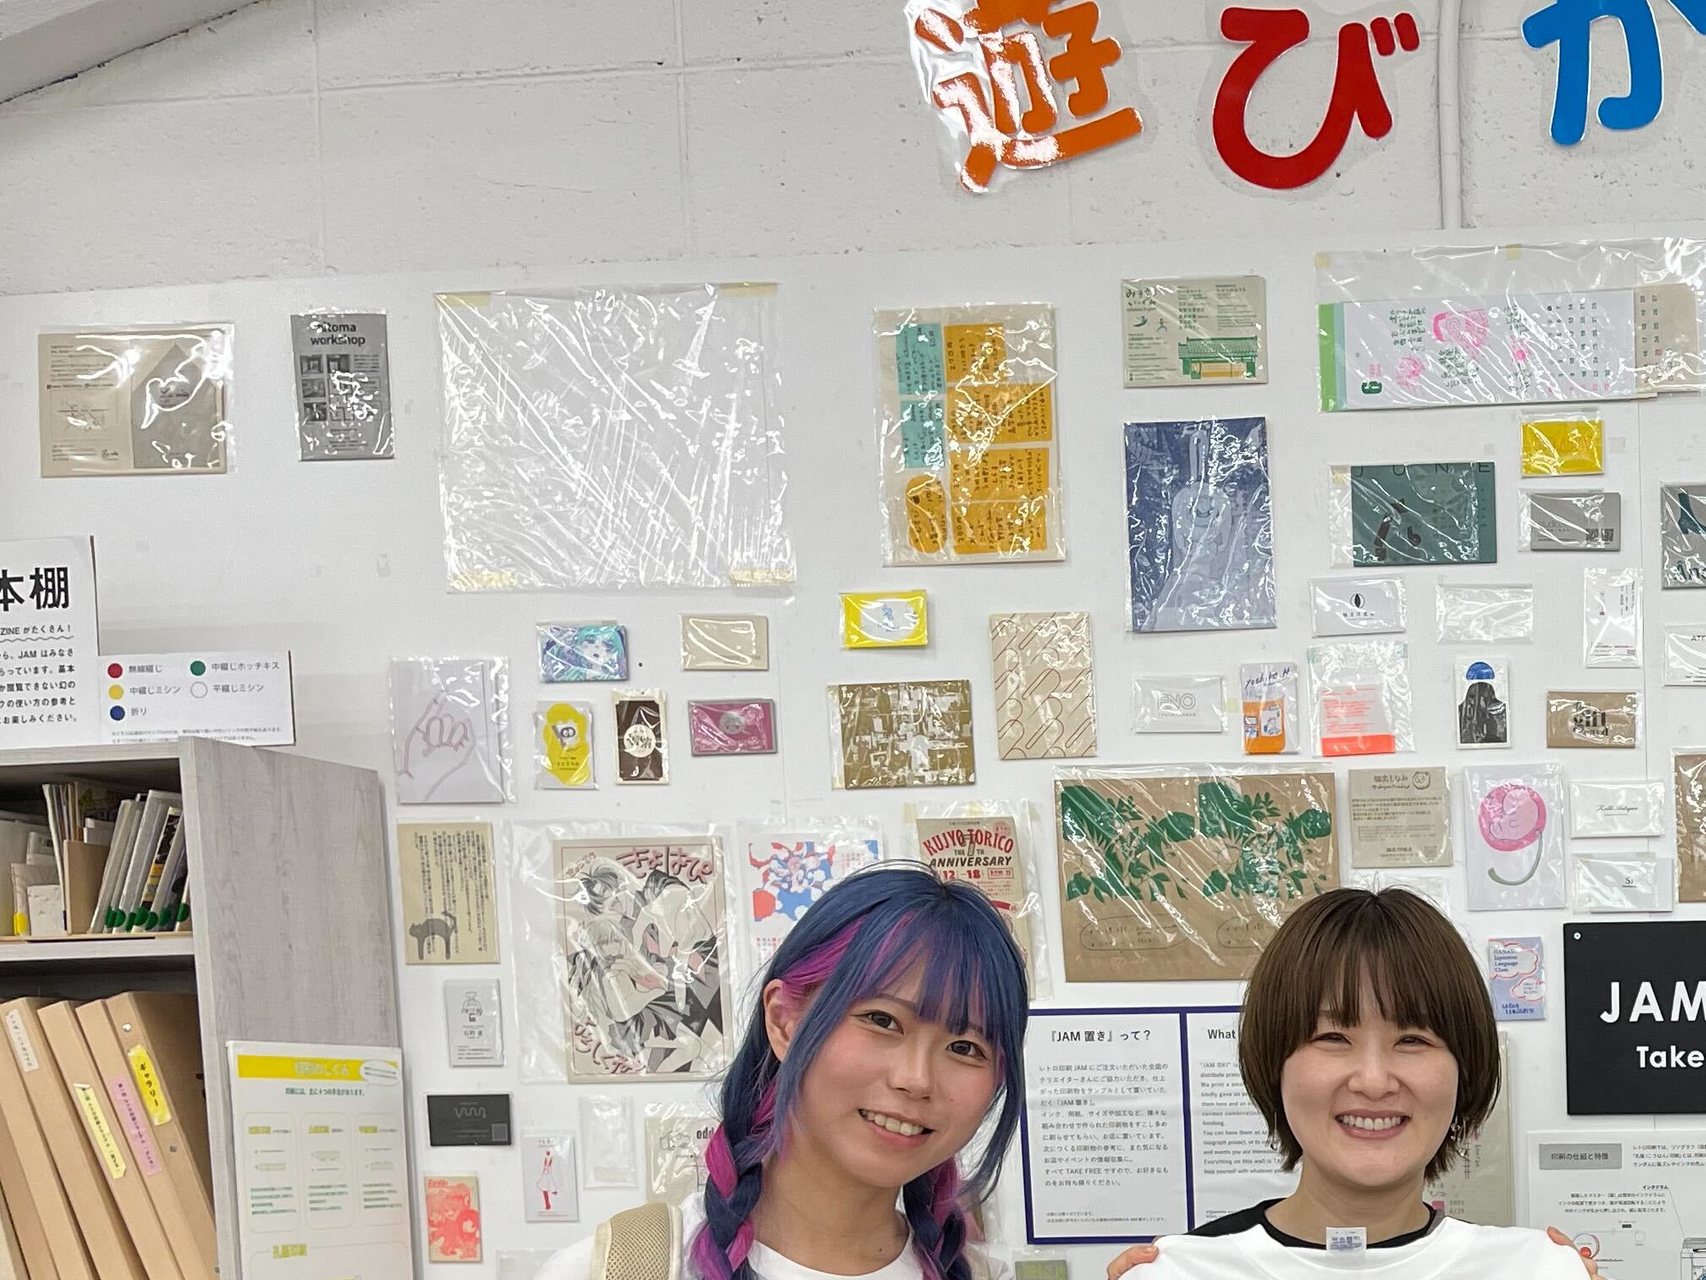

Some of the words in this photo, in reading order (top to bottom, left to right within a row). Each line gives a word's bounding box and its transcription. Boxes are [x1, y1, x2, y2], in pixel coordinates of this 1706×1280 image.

[310, 334, 366, 347] workshop
[18, 649, 37, 659] JAM
[130, 685, 181, 696] 中綴じミシン
[929, 855, 1013, 868] ANNIVERSARY
[1207, 1028, 1237, 1040] What
[1636, 1044, 1704, 1069] Take
